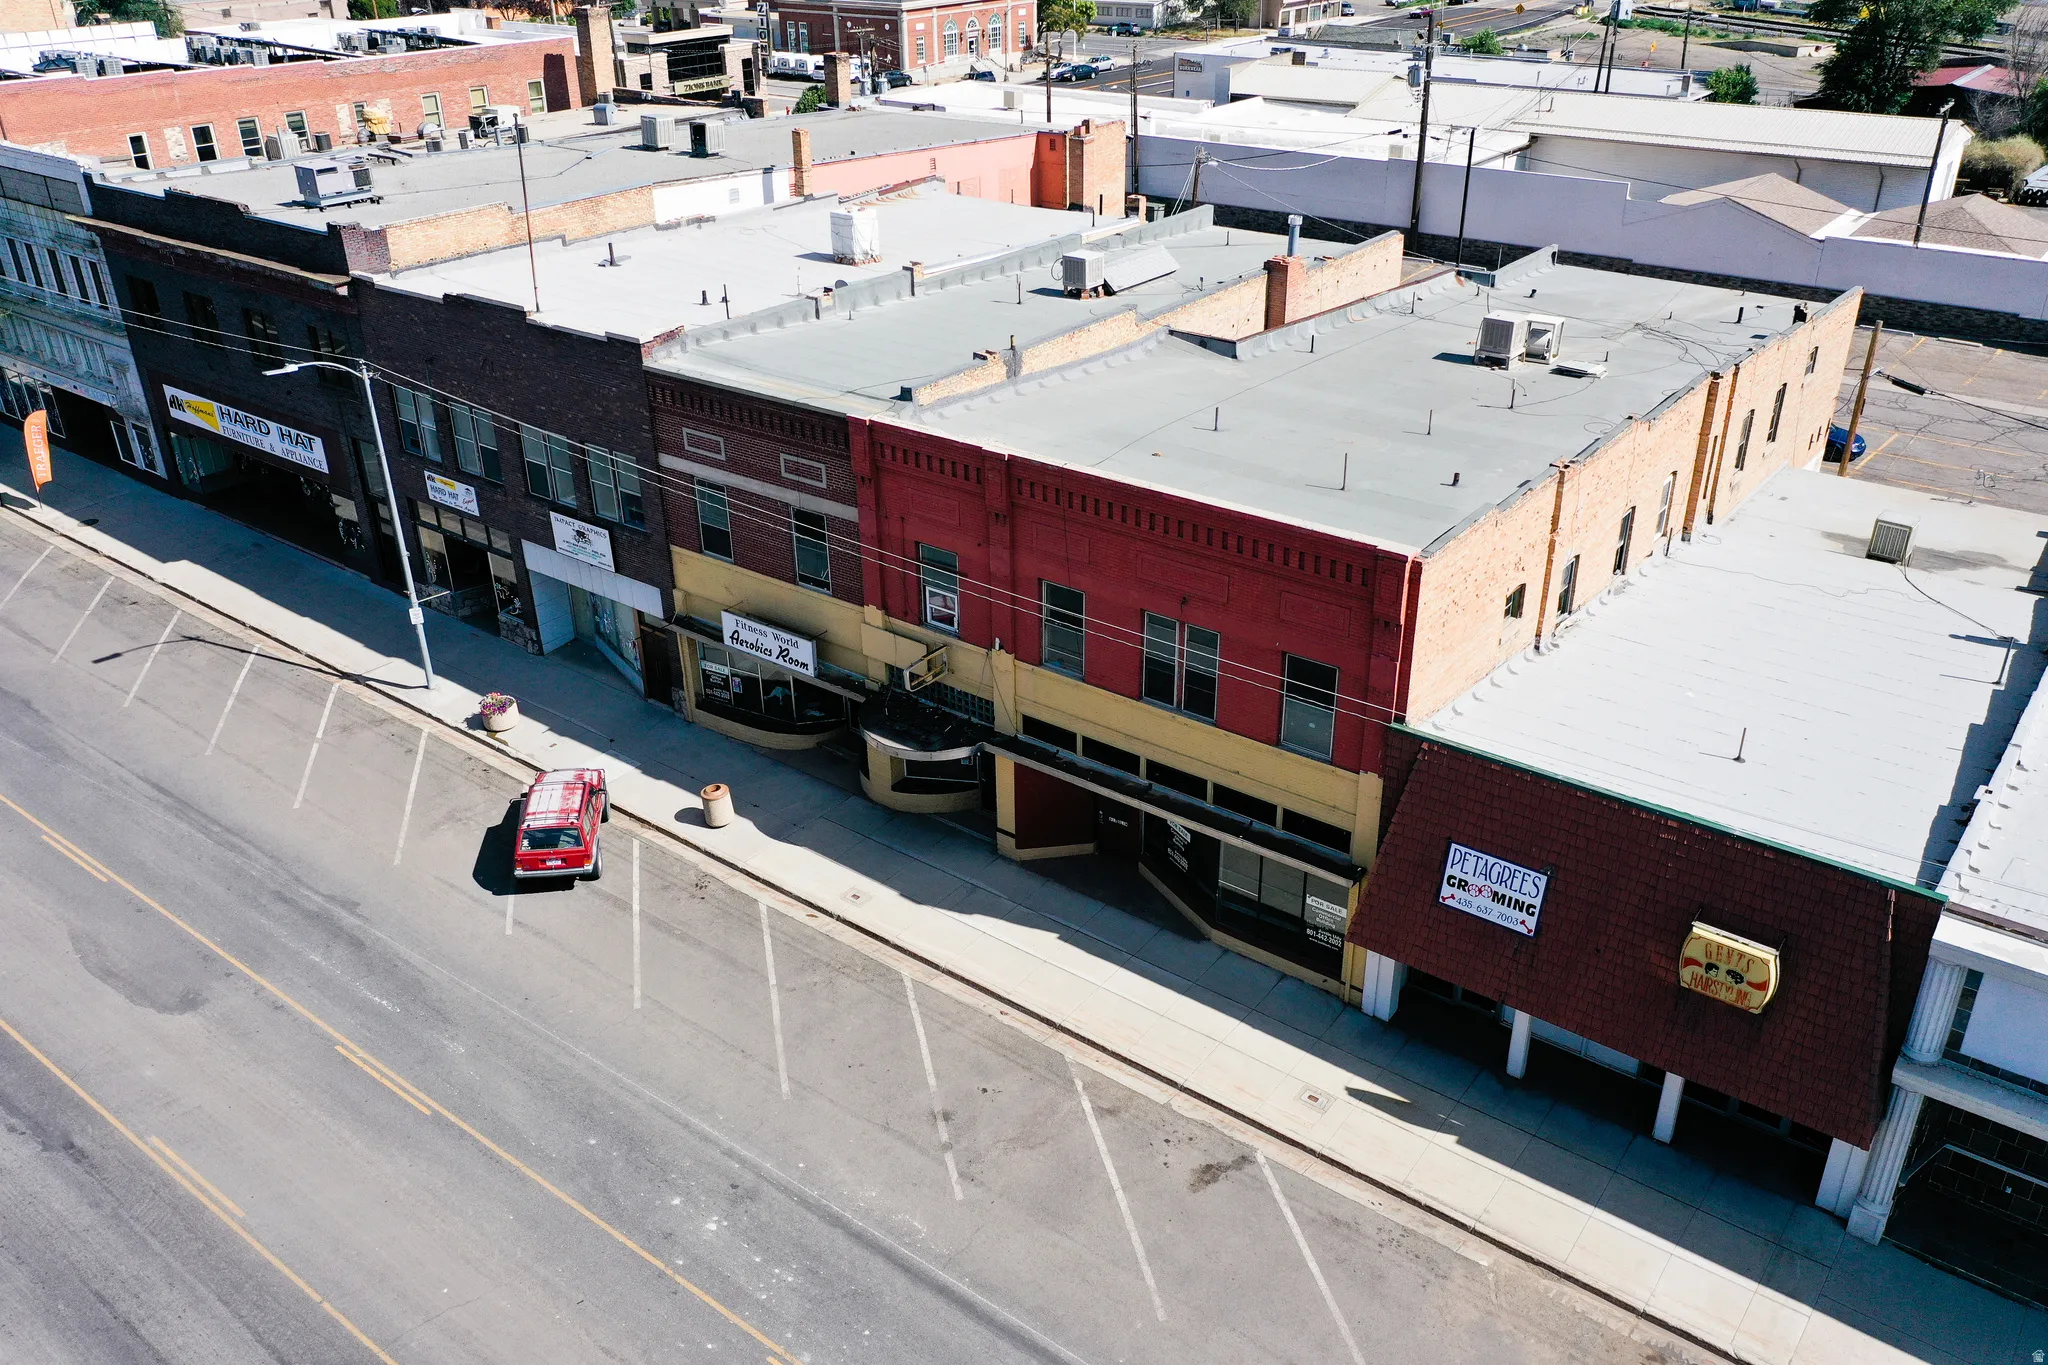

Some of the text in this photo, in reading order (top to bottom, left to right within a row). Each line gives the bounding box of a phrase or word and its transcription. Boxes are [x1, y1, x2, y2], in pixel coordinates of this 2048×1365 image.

[705, 79, 723, 88] BANK
[217, 405, 316, 453] HARD HAT
[31, 425, 47, 476] TRAEGER
[222, 426, 325, 471] FURNITURE & APPLIANCE
[430, 485, 459, 501] HARD HAT
[554, 516, 607, 539] IMPACT GRAPHICS
[735, 619, 799, 649] Fitness World
[729, 629, 809, 671] Aerobics Room
[714, 665, 725, 673] SALE
[1450, 848, 1541, 898] PETAGREES
[1311, 899, 1342, 914] FOR SALE
[1446, 874, 1537, 917] GROOMING
[1312, 907, 1341, 921] Commercial
[1456, 897, 1519, 926] 435-637-7003
[1306, 928, 1342, 947] 801-442-2002
